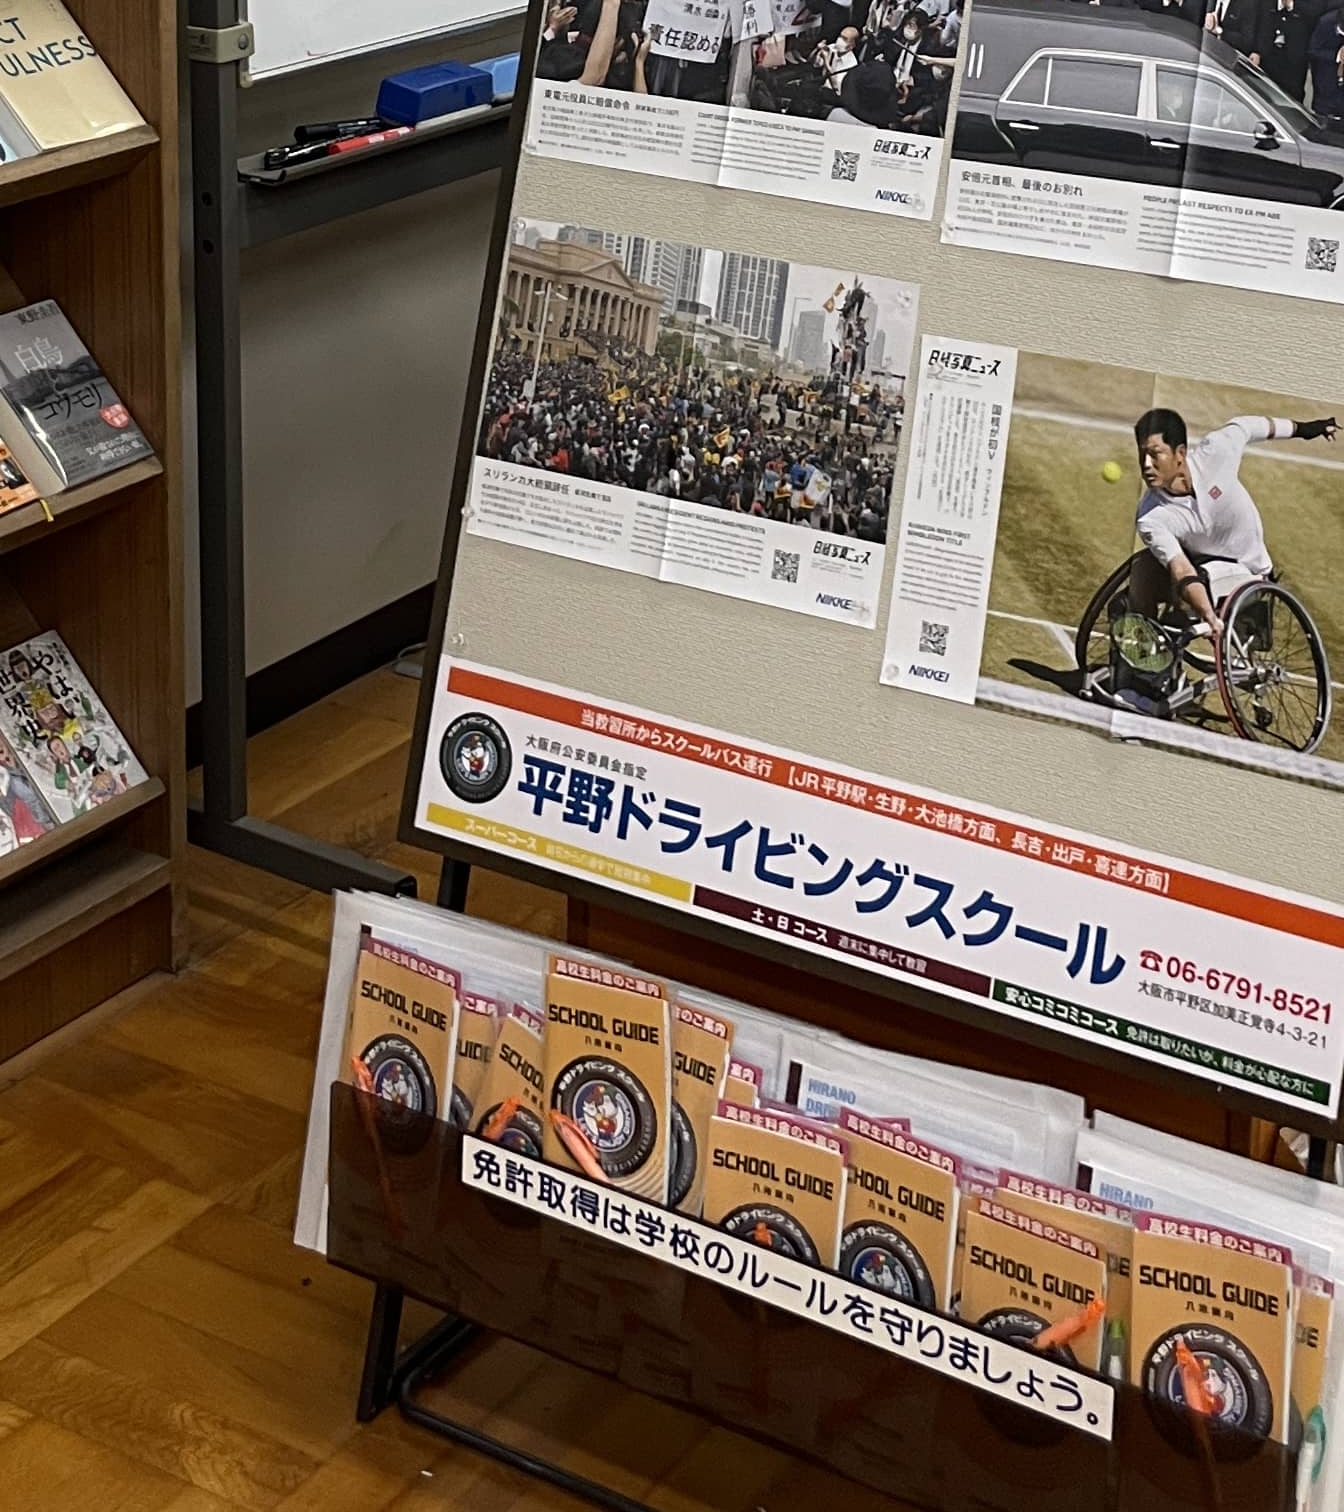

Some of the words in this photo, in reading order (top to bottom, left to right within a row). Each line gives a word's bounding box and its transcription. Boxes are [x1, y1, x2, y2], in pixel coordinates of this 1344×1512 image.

[648, 22, 720, 54] 責任認める
[544, 88, 631, 112] 東電元役員に賠償命令
[961, 170, 1084, 197] 安倍元首相、最後のお別れ
[14, 335, 64, 374] 白鳥
[37, 382, 103, 421] コウモリ
[484, 467, 570, 496] スリランカ大統領辞任
[815, 592, 856, 611] NIKKE
[32, 650, 81, 721] やばい
[909, 664, 951, 683] NIKKEI
[525, 734, 648, 781] 大阪府公安委員会指定
[581, 708, 773, 776] 当教習所からスクールバス運行
[464, 816, 538, 849] スーパーコース
[517, 754, 1127, 985] 平野ドライビングスクール
[752, 907, 789, 932] 土・日
[793, 918, 829, 943] コース
[372, 943, 457, 988] 高校生料金のご案内
[556, 959, 660, 996] 高校生料金のご案内
[361, 980, 408, 1014] SCHOOL
[412, 1004, 448, 1033] GUIDE
[1004, 986, 1119, 1037] 安心コミコミコース
[1166, 959, 1332, 1026] 06-6791-8521
[547, 1003, 609, 1034] SCHOOL
[612, 1017, 660, 1045] GUIDE
[807, 1076, 857, 1105] HIRANO
[725, 1101, 844, 1155] 高校生料金のご案内
[846, 1113, 955, 1172] 高校生料金のご案内
[712, 1149, 780, 1183] SCHOOL
[785, 1167, 834, 1201] GUIDE
[1099, 1182, 1154, 1210] HIRANO
[898, 1186, 945, 1223] GUIDE
[978, 1196, 1098, 1258] 高校生料金のご案内
[1149, 1216, 1283, 1264] 高校生料金のご案内
[472, 1149, 1101, 1426] 免許取得は学校のルールを守りましょう。
[970, 1245, 1038, 1289] SCHOOL
[1139, 1265, 1217, 1299] SCHOOL
[1222, 1281, 1279, 1317] GUIDE
